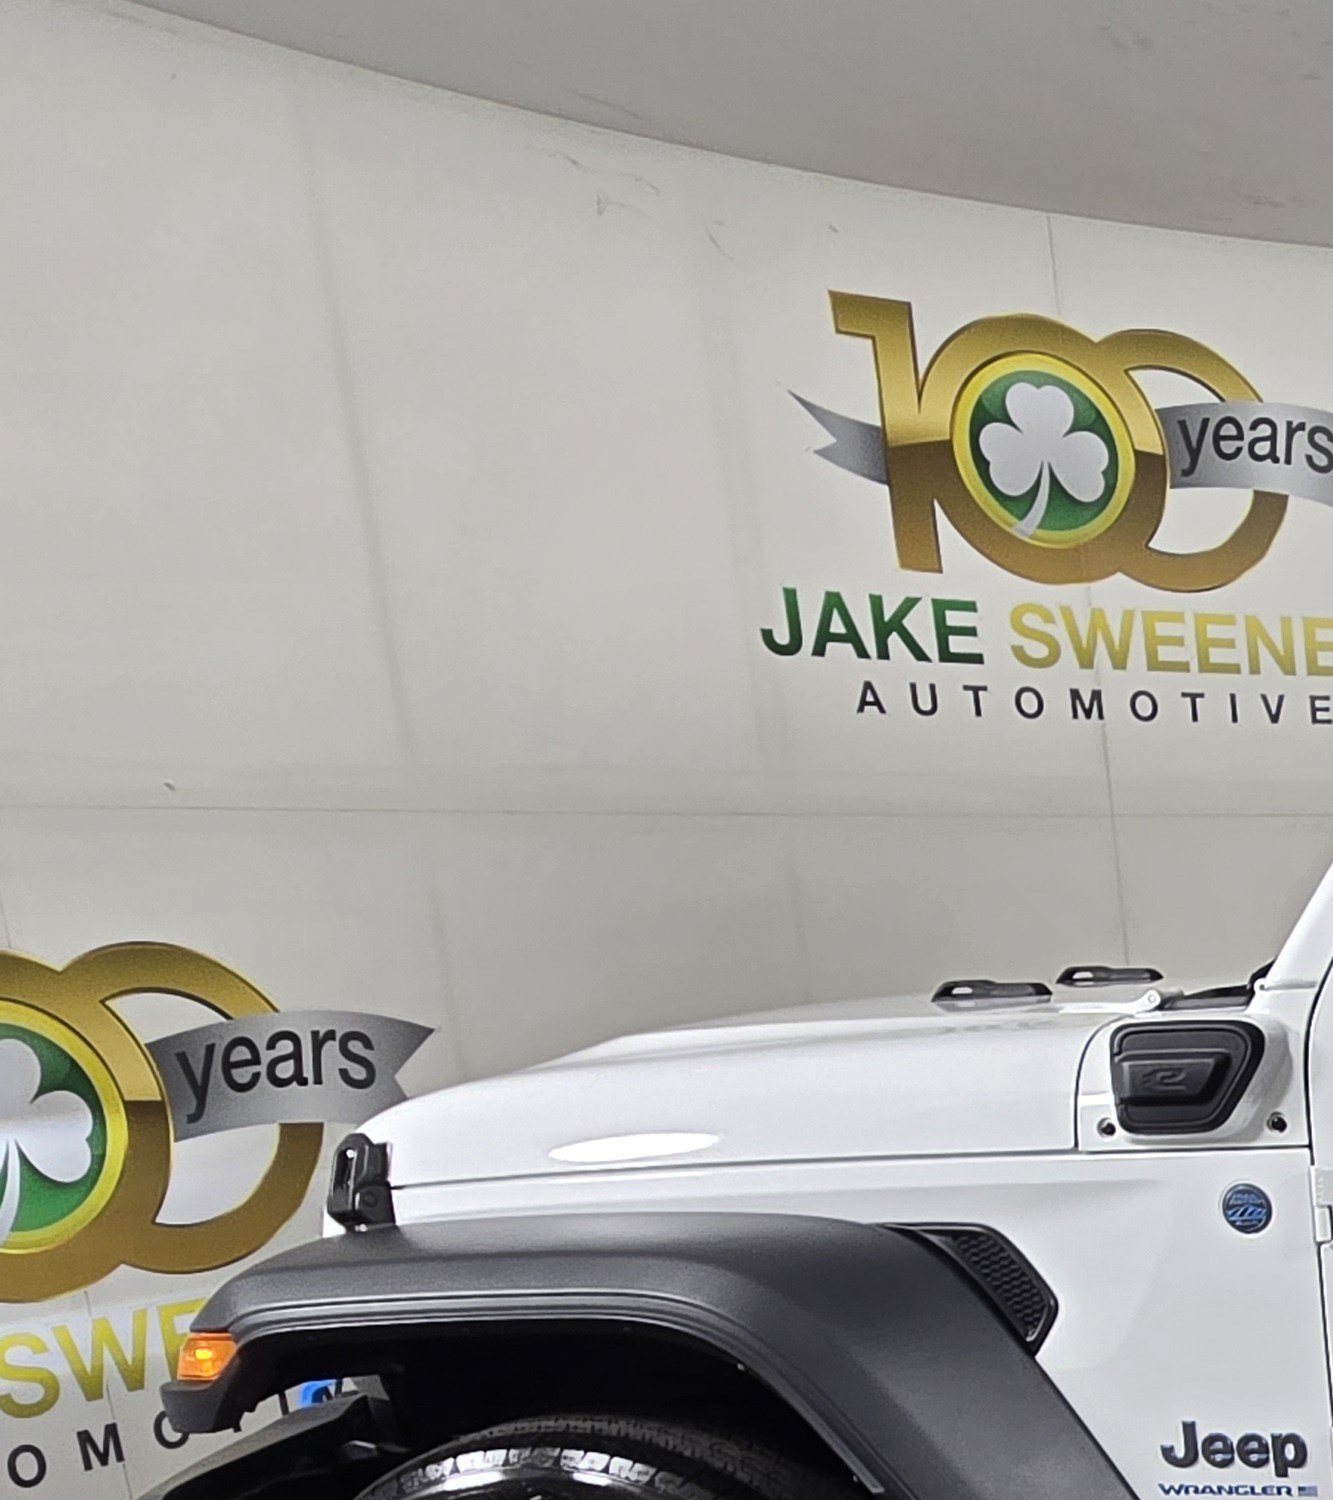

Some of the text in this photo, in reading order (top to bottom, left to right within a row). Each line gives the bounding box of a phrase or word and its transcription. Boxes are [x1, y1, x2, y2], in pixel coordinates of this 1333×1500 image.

[828, 289, 1289, 593] 100
[760, 586, 985, 666] JAKE
[857, 681, 1333, 725] AUTOMOTIVE
[174, 1028, 376, 1123] years
[1160, 1421, 1308, 1477] Jeep
[1158, 1483, 1293, 1497] WRANGLER
